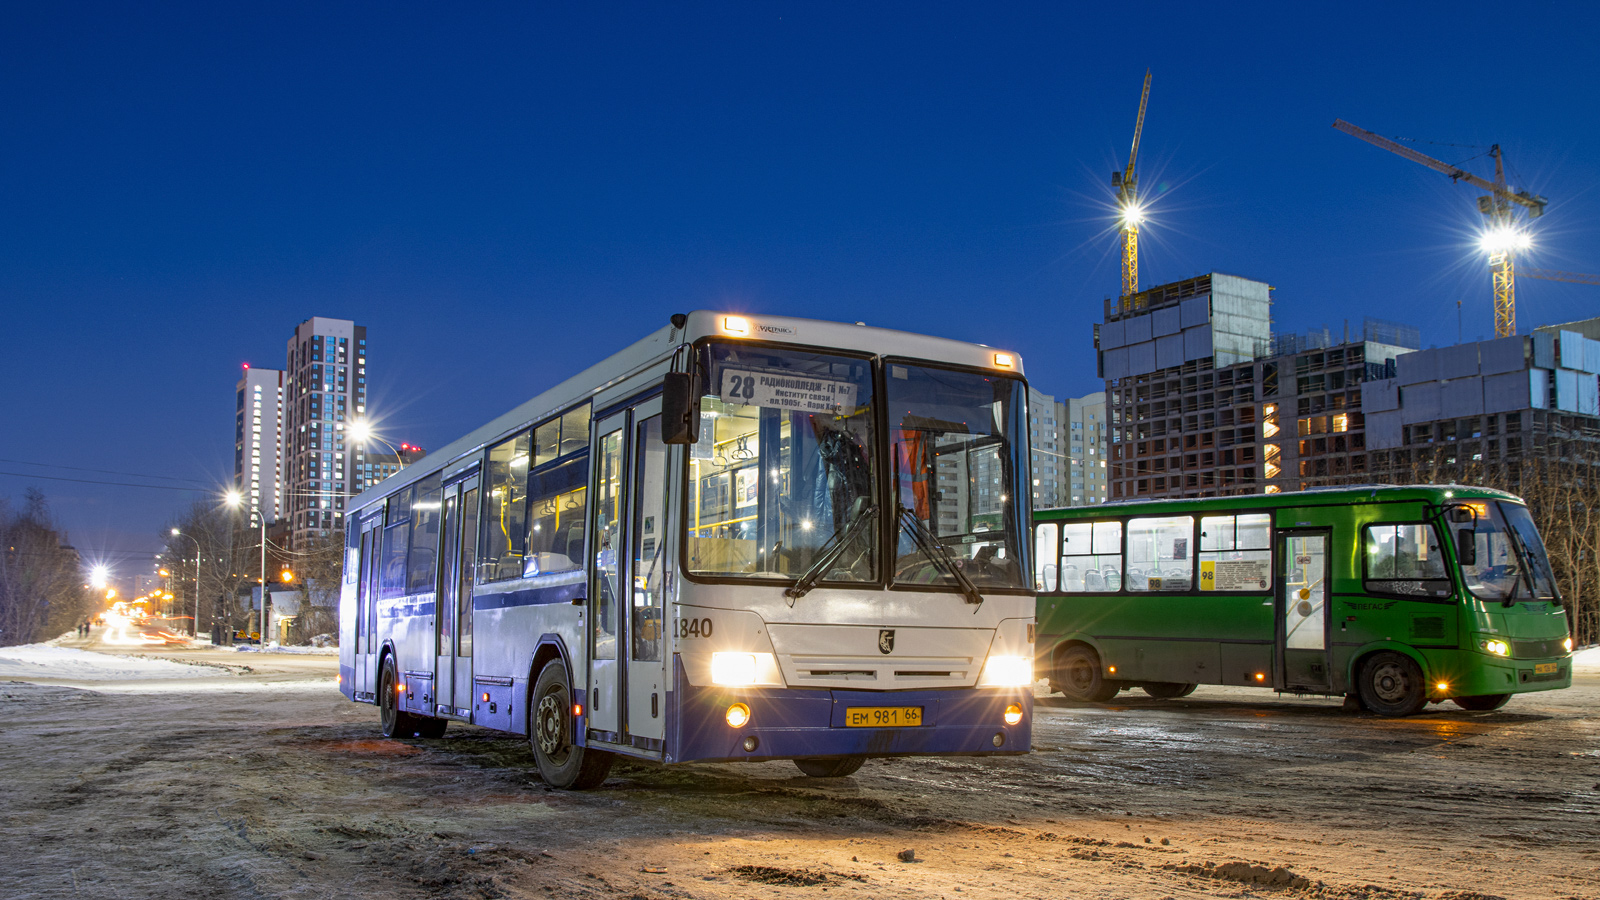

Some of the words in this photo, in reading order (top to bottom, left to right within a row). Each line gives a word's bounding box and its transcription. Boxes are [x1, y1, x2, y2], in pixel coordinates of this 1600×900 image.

[729, 375, 755, 399] 28
[760, 376, 822, 392] РАДИОКОЛЛЕДЖ
[839, 386, 851, 395] №7
[775, 389, 808, 399] Институт
[807, 401, 825, 410] Парк
[1202, 571, 1214, 580] 98
[1150, 579, 1161, 588] 98
[673, 618, 713, 639] 1840
[874, 710, 897, 724] 981
[905, 709, 917, 720] 66
